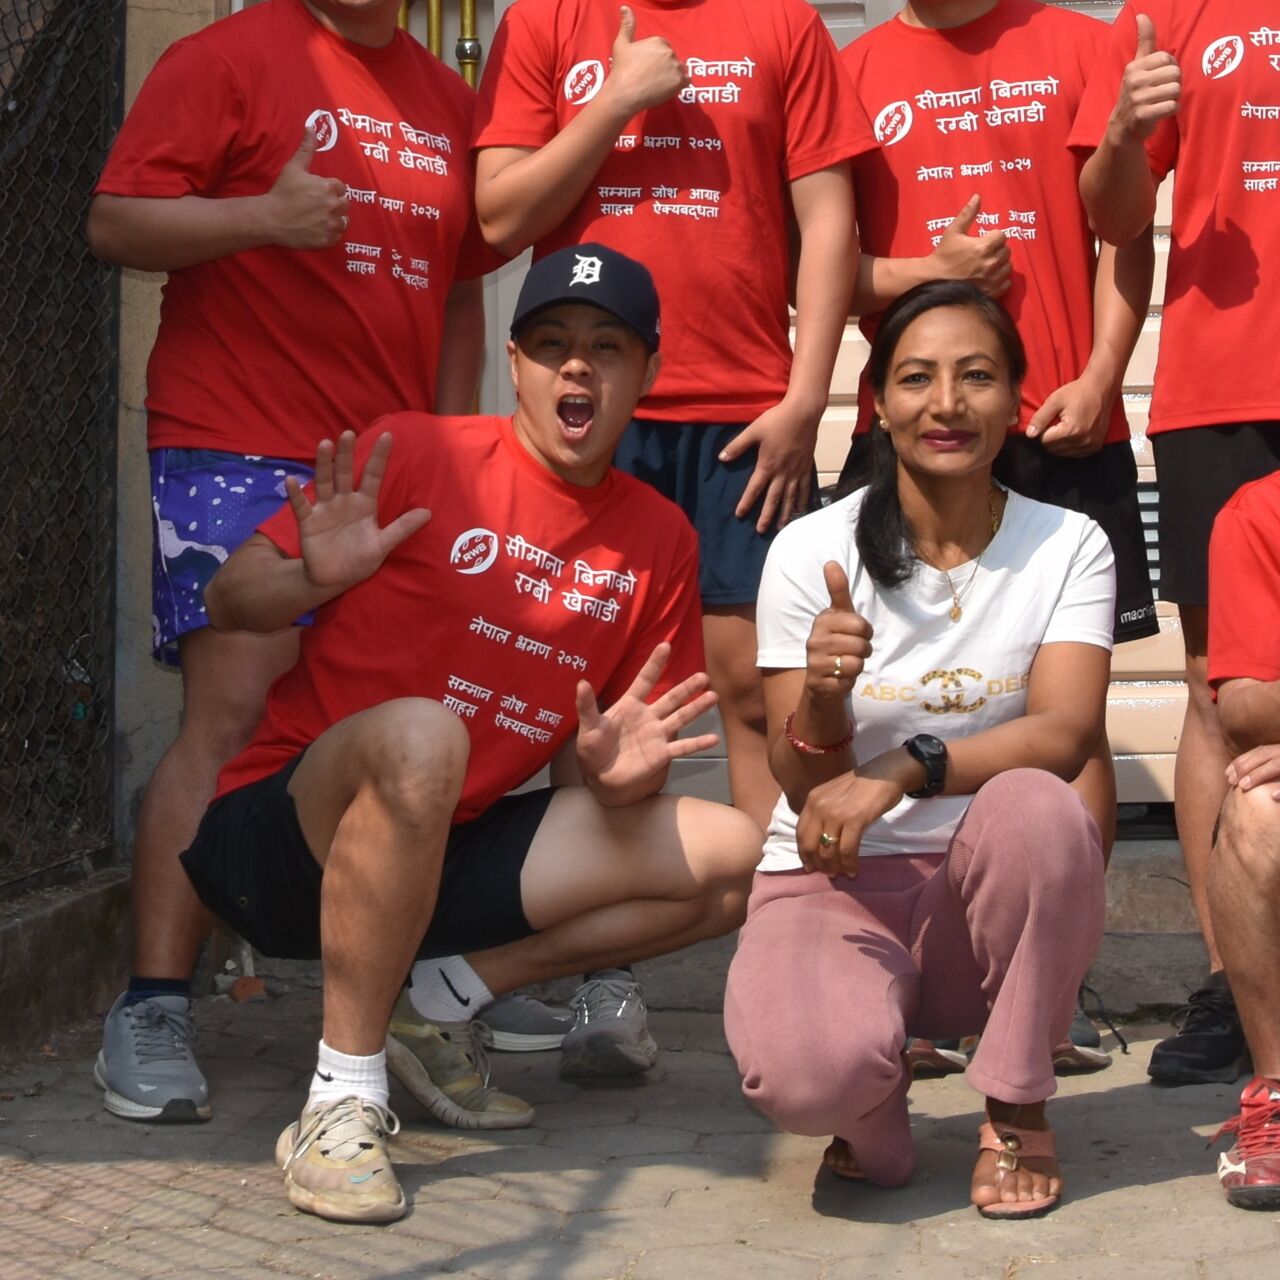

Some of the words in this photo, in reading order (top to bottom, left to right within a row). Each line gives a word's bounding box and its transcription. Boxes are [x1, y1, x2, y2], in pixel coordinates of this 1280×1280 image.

[686, 57, 755, 78] बिनाको
[1213, 46, 1232, 69] RWB
[575, 73, 593, 95] RWB
[678, 81, 741, 104] खेलाडी
[914, 86, 982, 110] सीमाना
[989, 75, 1060, 100] बिनाको
[935, 111, 979, 134] रग्बी
[984, 100, 1046, 127] खेलाडी
[1241, 101, 1280, 119] नेपाल
[399, 121, 451, 153] बिनाको
[644, 136, 681, 148] भ्रमण
[689, 137, 721, 150] २०२५
[397, 147, 447, 176] खेलाडी
[916, 166, 954, 181] नेपाल
[960, 161, 993, 176] भ्रमण
[1000, 158, 1031, 171] २०२५
[599, 187, 642, 198] सम्मान
[652, 185, 678, 198] जोश
[689, 188, 720, 203] आग्रह
[1244, 178, 1279, 192] साहस
[344, 184, 376, 204] नेपाल
[411, 203, 440, 219] २०२५
[601, 204, 634, 216] साहस
[976, 212, 999, 225] जोश
[345, 243, 381, 258] सम्मान
[347, 260, 376, 274] साहस
[569, 254, 603, 286] D
[462, 543, 487, 562] RWB
[505, 535, 565, 577] सीमाना
[574, 560, 637, 595] बिनाको
[515, 572, 553, 604] रग्बी
[561, 588, 621, 623] खेलाडी
[470, 616, 512, 643] नेपाल
[515, 635, 552, 659] भ्रमण
[558, 650, 587, 671] २०२५
[448, 675, 494, 701] सम्मान
[500, 695, 528, 714] जोश
